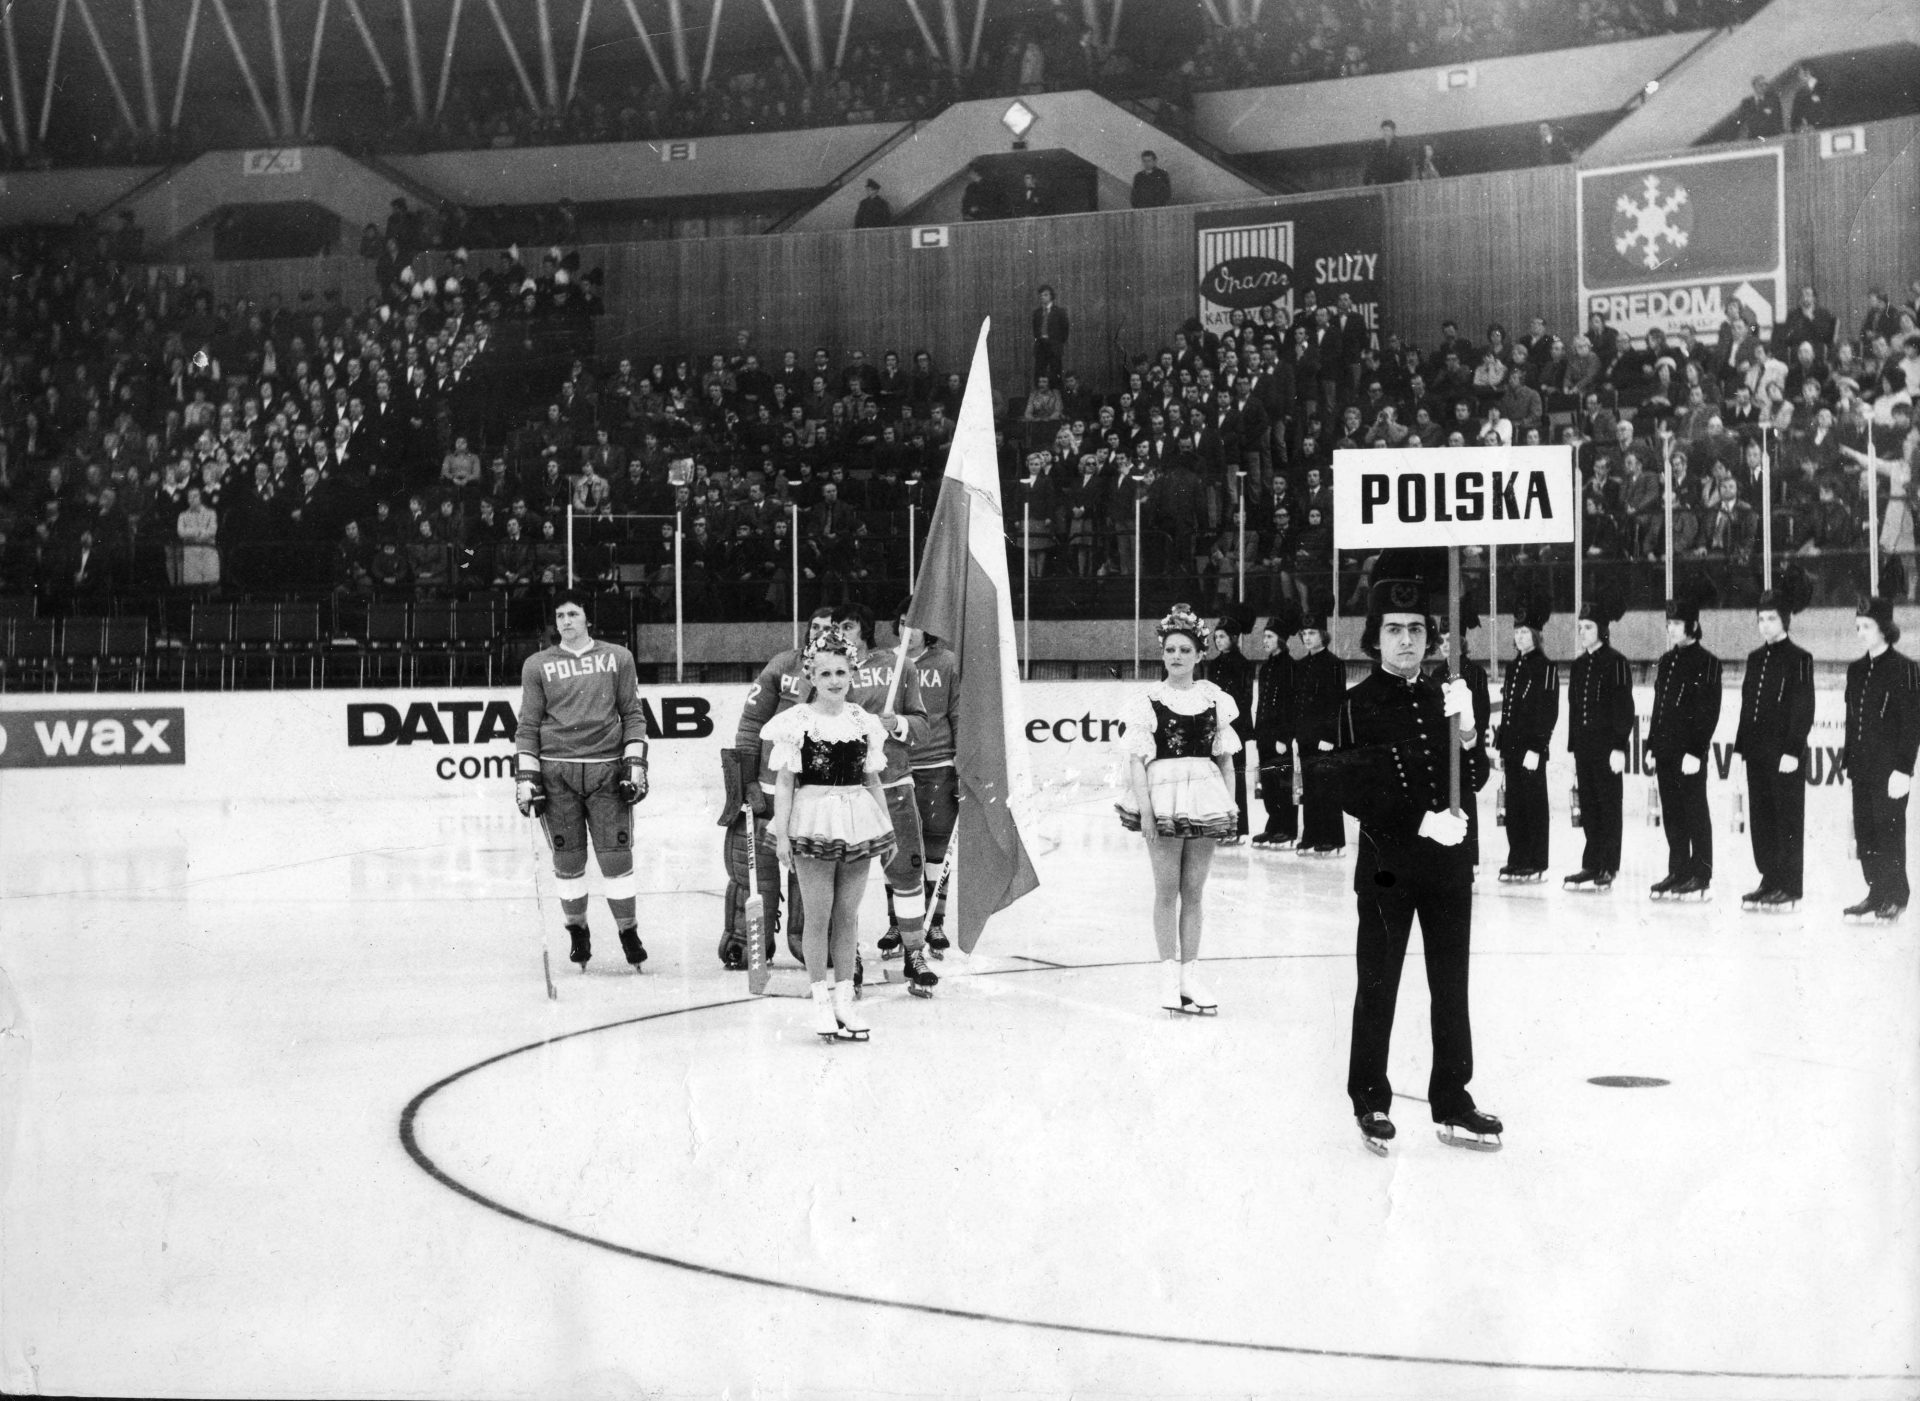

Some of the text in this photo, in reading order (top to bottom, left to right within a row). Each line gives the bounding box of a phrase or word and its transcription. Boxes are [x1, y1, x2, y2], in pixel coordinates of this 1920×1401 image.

[670, 143, 689, 161] B
[920, 228, 940, 247] C
[1591, 285, 1722, 322] PREDOM
[1361, 470, 1554, 525] POLSKA
[543, 653, 618, 682] POLSKA
[33, 719, 172, 757] wax
